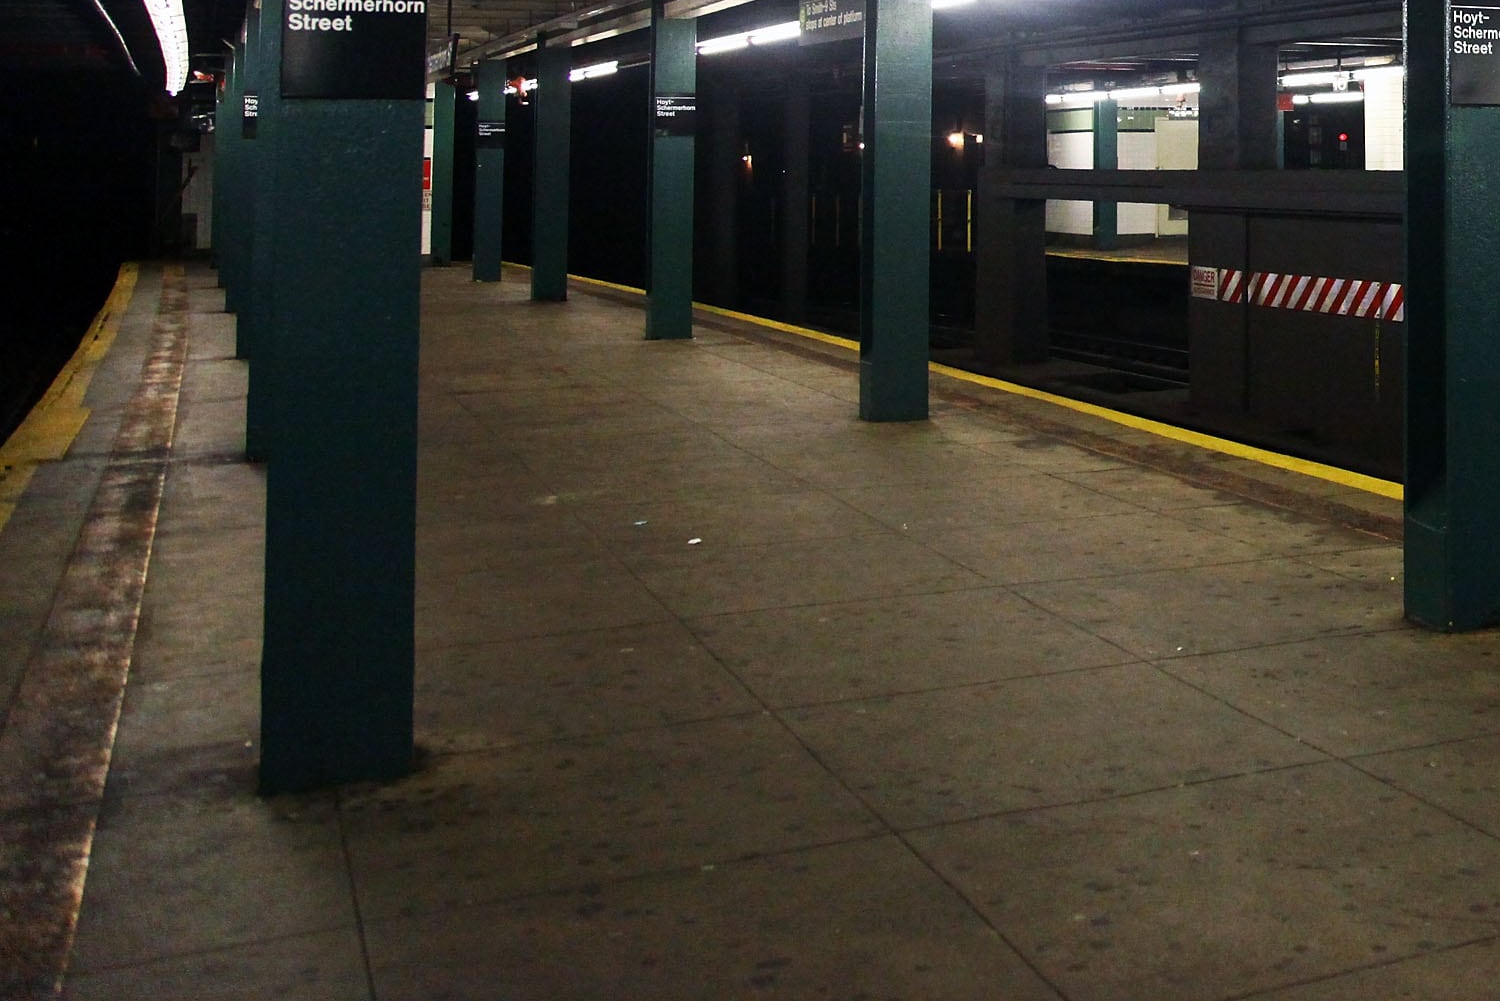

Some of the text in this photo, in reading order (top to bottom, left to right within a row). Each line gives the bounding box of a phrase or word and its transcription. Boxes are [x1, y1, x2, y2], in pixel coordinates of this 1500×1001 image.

[288, 13, 352, 31] Street
[1453, 10, 1490, 26] Hoyt-
[1453, 41, 1493, 54] Street
